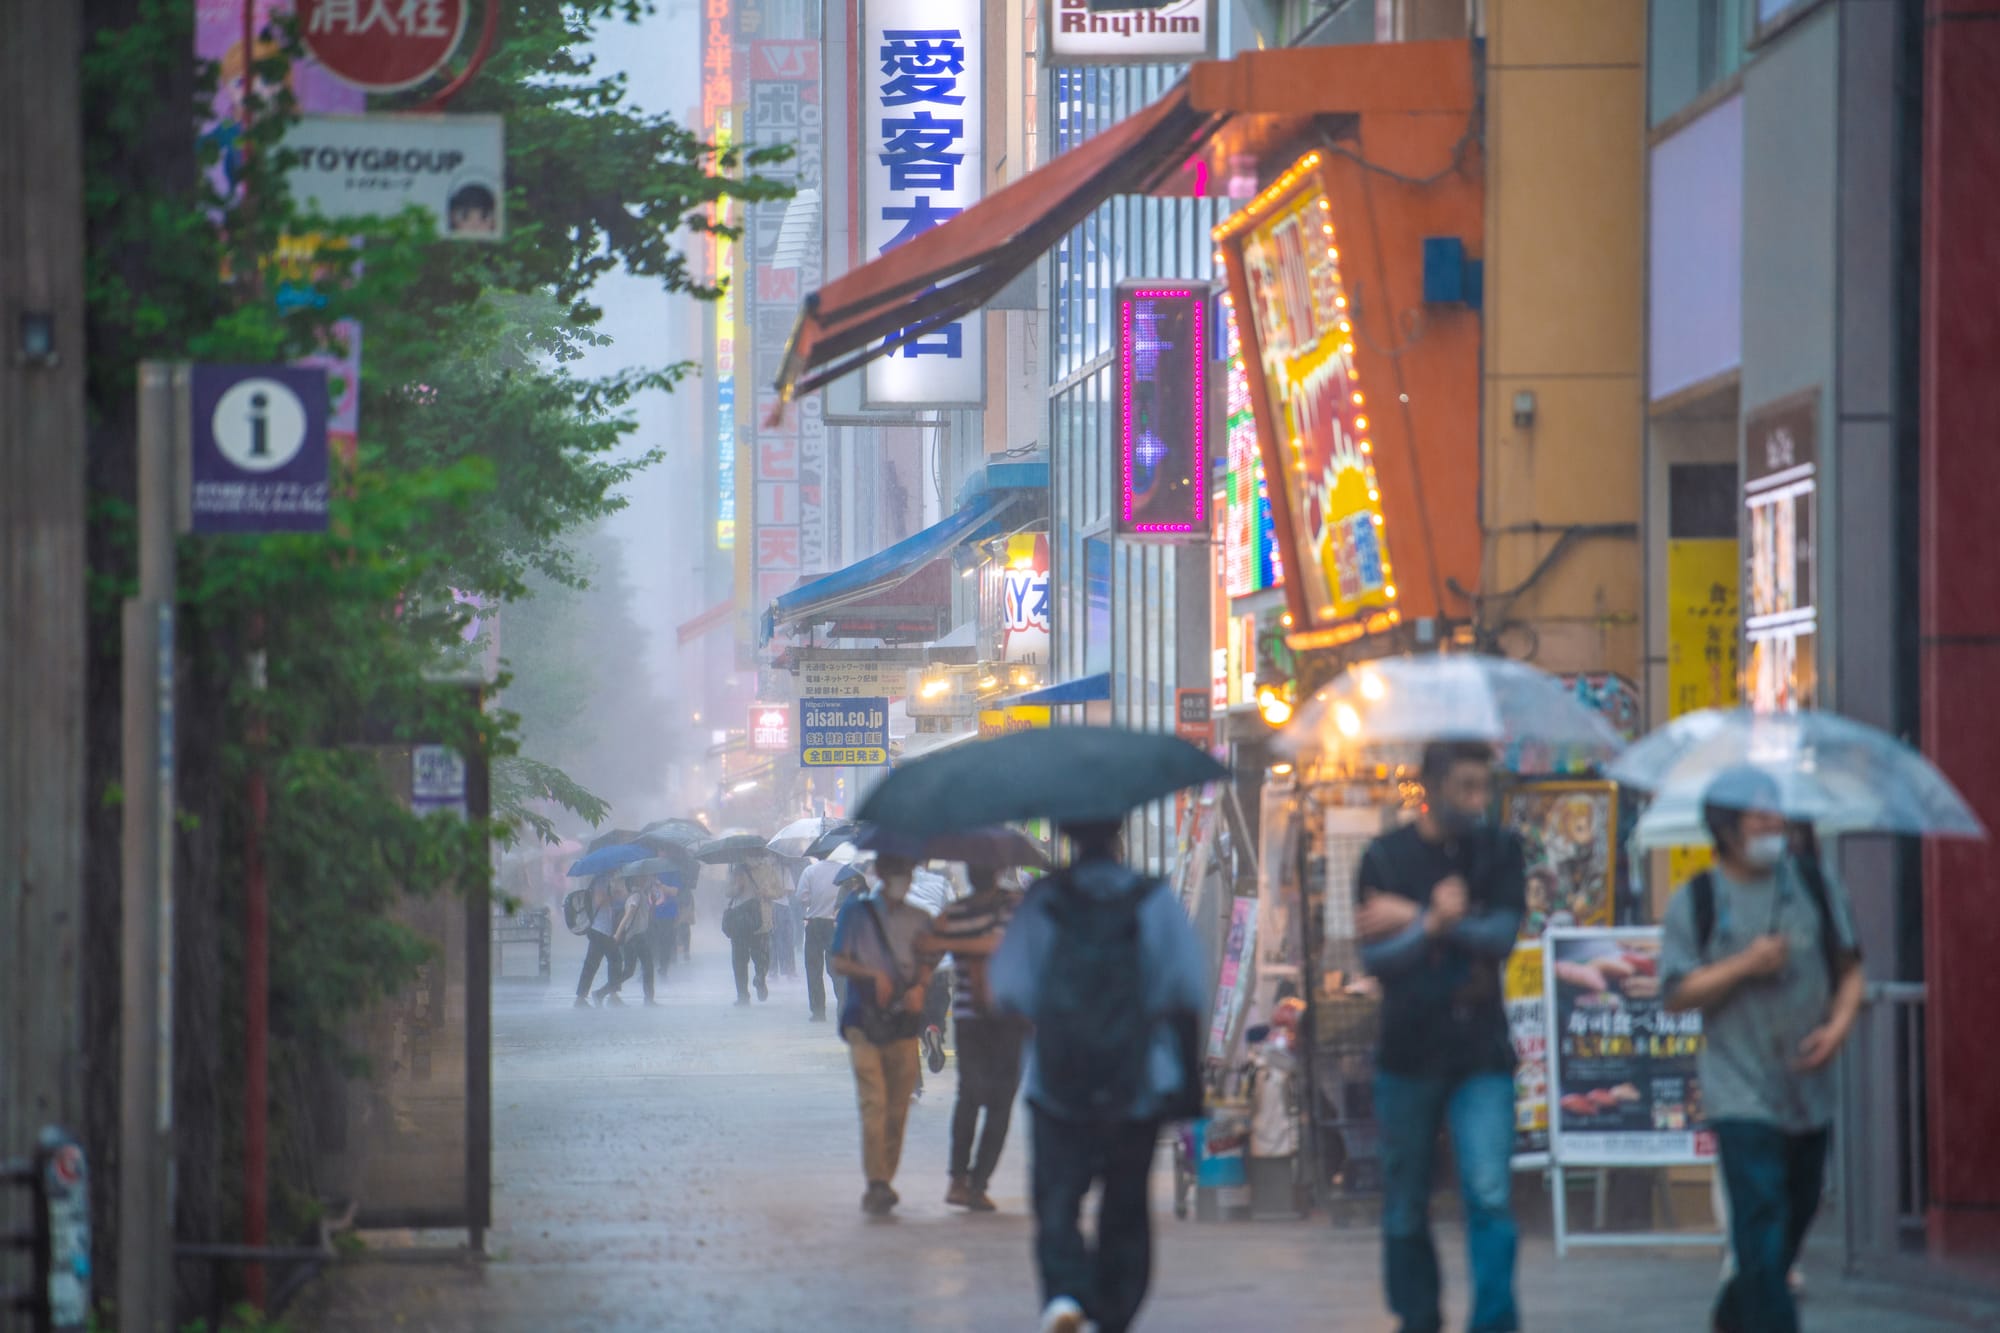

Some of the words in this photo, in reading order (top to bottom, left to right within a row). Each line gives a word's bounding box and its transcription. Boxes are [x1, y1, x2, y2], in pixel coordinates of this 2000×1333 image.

[1061, 11, 1199, 37] Rhythm
[299, 146, 463, 173] TOYGROUP
[806, 708, 883, 728] aisan.co.jp
[810, 750, 879, 762] 全国即日発送
